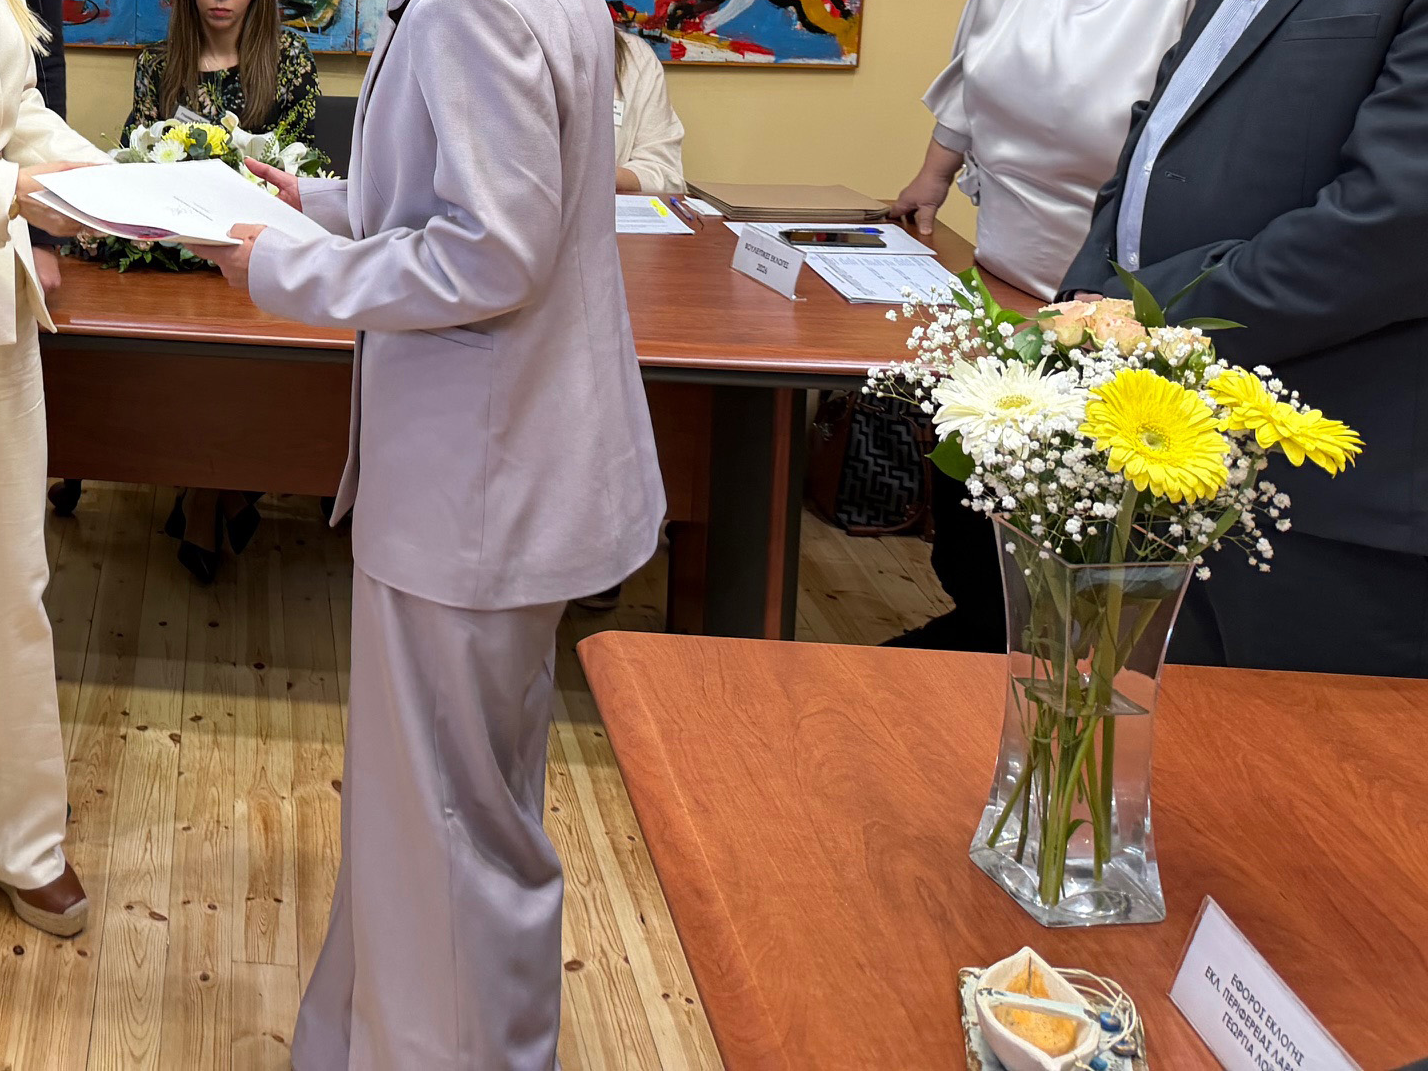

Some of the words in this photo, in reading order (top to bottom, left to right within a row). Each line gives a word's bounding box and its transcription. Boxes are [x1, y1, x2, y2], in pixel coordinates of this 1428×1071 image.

[1205, 965, 1220, 992] ΕΚΛ.
[1222, 987, 1272, 1053] ΠΕΡΙΦΕΡΕΙΑΣ
[1271, 1049, 1295, 1071] ΛΑΡ
[1222, 1012, 1254, 1057] ΓΕΩΡΓΙΑ
[1231, 973, 1266, 1020] ΕΦΟΡΟΣ
[1265, 1015, 1304, 1066] ΕΚΛΟΓΗΣ
